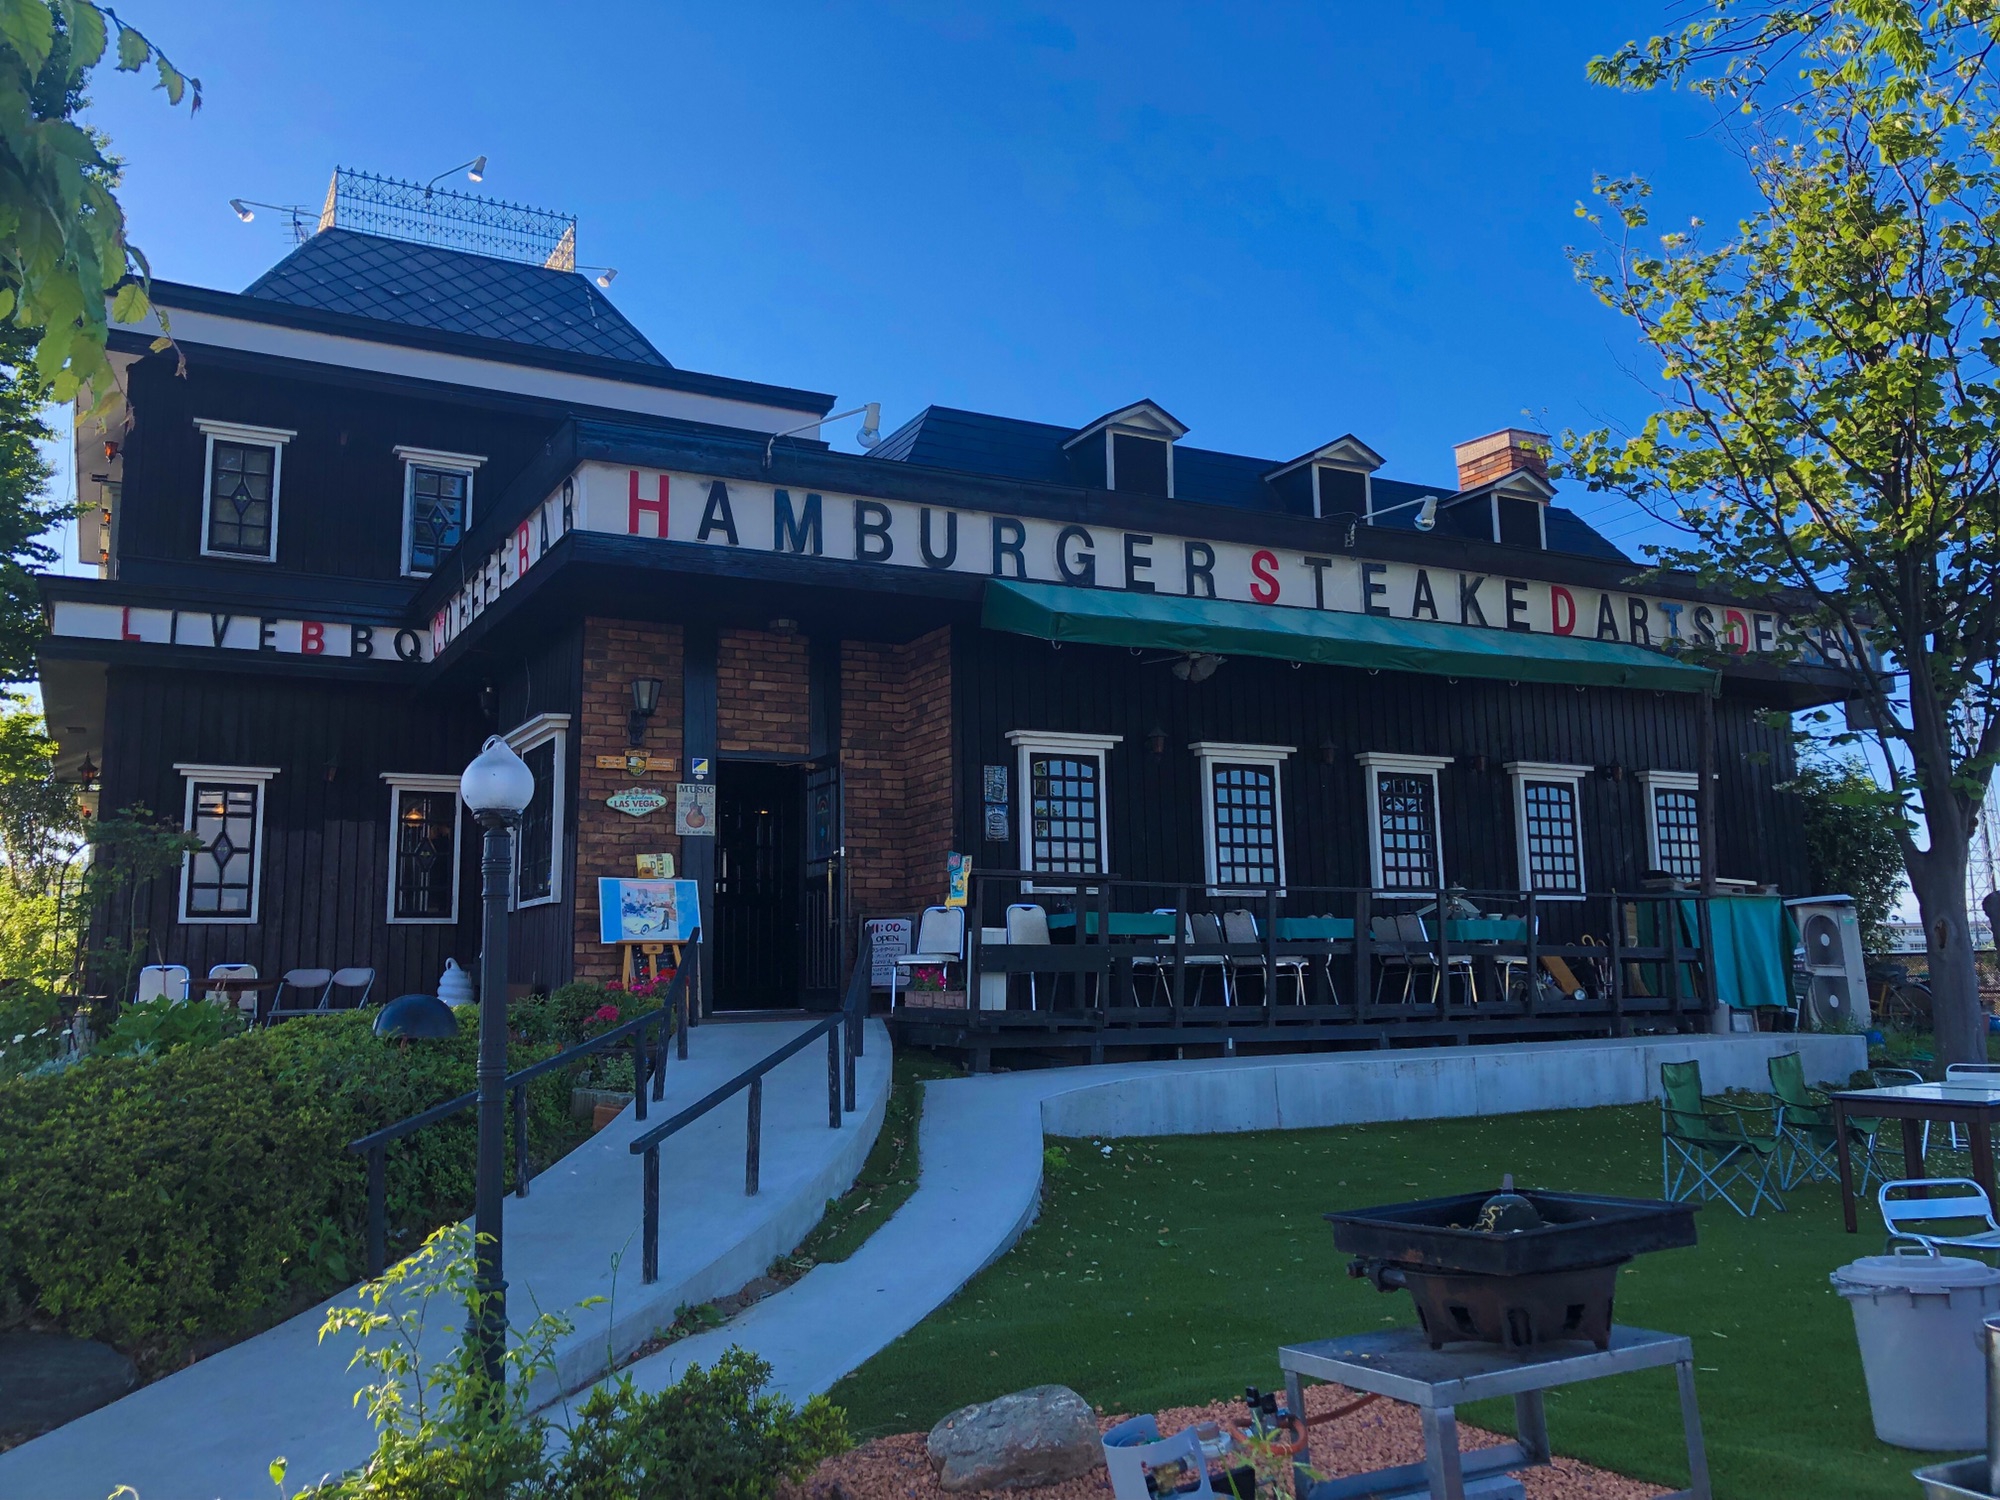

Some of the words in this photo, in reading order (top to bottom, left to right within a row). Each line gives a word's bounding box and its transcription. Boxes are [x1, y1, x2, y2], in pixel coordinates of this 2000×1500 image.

[433, 537, 513, 658] COFFEE
[518, 475, 574, 578] BAR
[627, 469, 1216, 598] HAMBURGER
[1249, 549, 1532, 631] STEAKE
[1551, 585, 1716, 649] DARTS
[121, 606, 278, 651] LIVE
[301, 620, 423, 662] BBQ
[614, 800, 630, 808] LAS
[632, 800, 660, 808] VEGAS
[679, 785, 714, 794] MUSIC
[876, 935, 899, 943] OPEN
